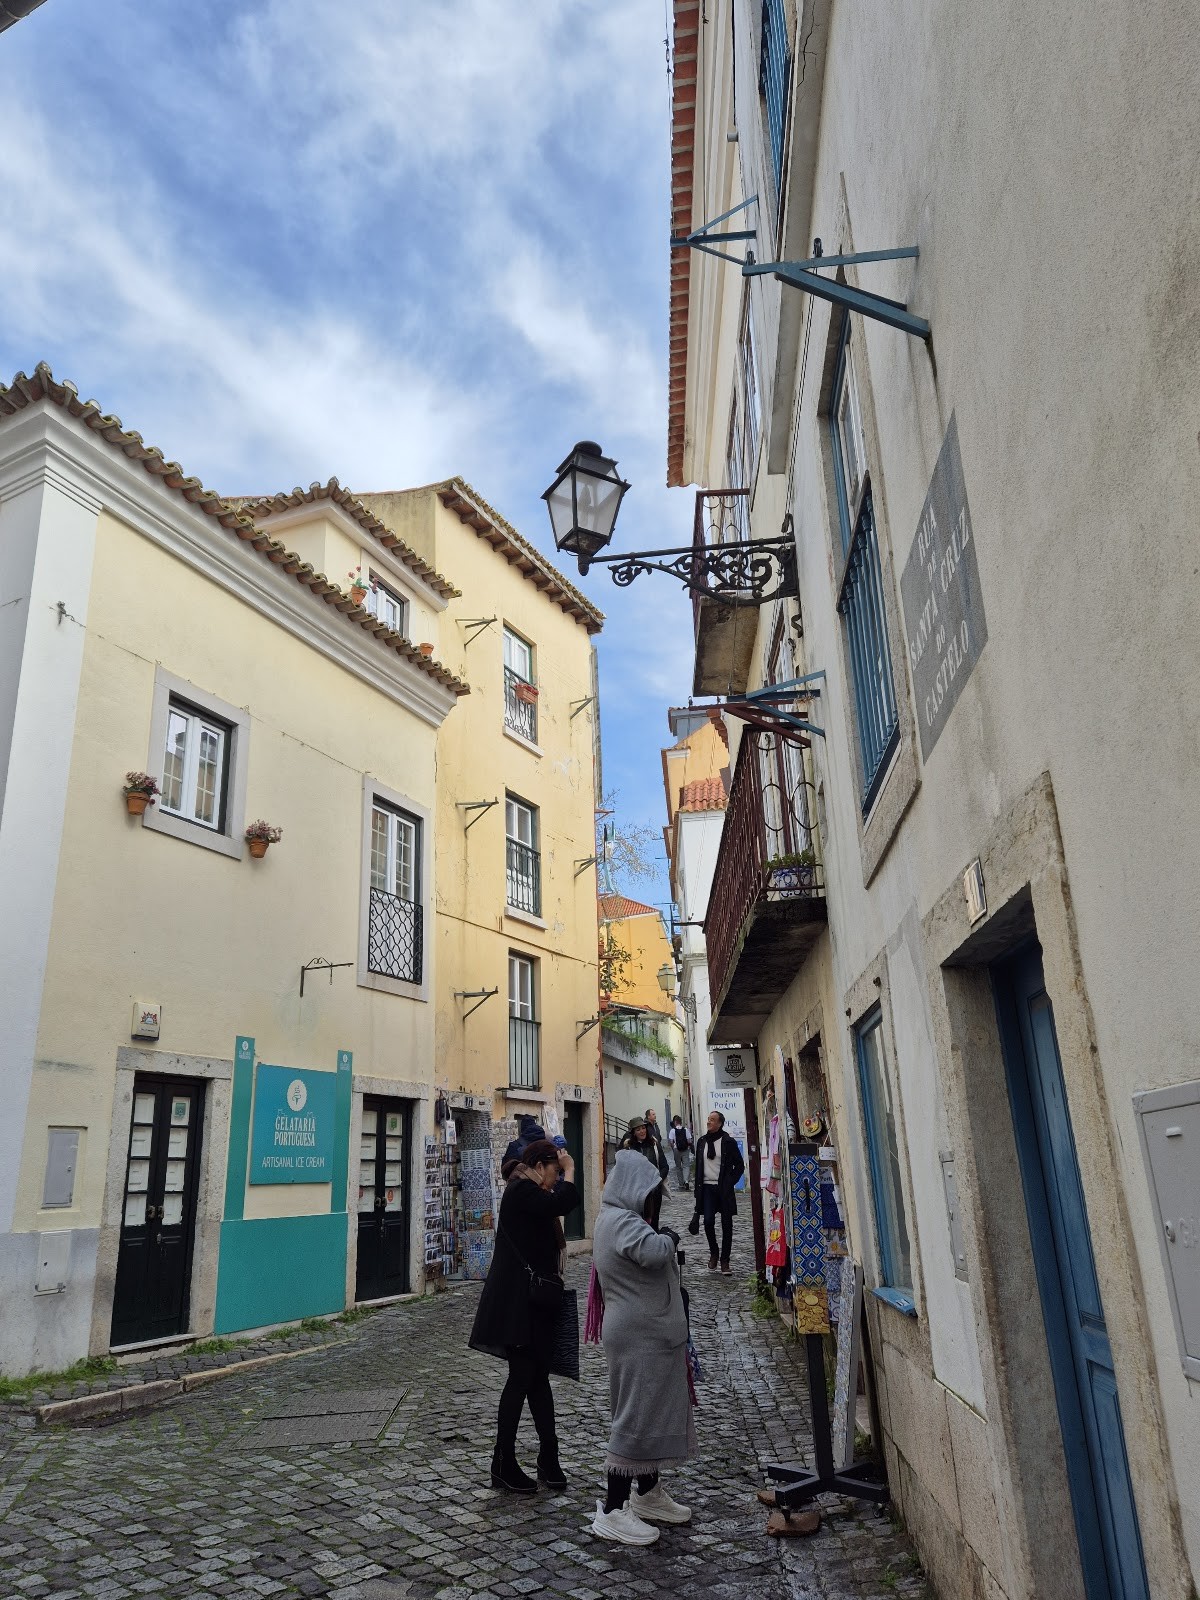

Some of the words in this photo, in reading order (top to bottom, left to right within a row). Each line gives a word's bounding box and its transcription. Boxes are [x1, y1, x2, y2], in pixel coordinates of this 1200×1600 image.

[917, 503, 938, 567] RUA
[927, 551, 937, 583] DE
[909, 590, 939, 672] SANTA
[940, 506, 970, 593] CRUZ
[936, 624, 946, 654] DO
[925, 619, 969, 727] CASTELO
[714, 1100, 737, 1110] Point
[274, 1131, 316, 1146] PORTUGUESA
[275, 1116, 316, 1131] GELATARIA
[262, 1156, 294, 1168] ARTISANAL
[295, 1156, 304, 1168] ICE
[305, 1156, 325, 1168] CREAM
